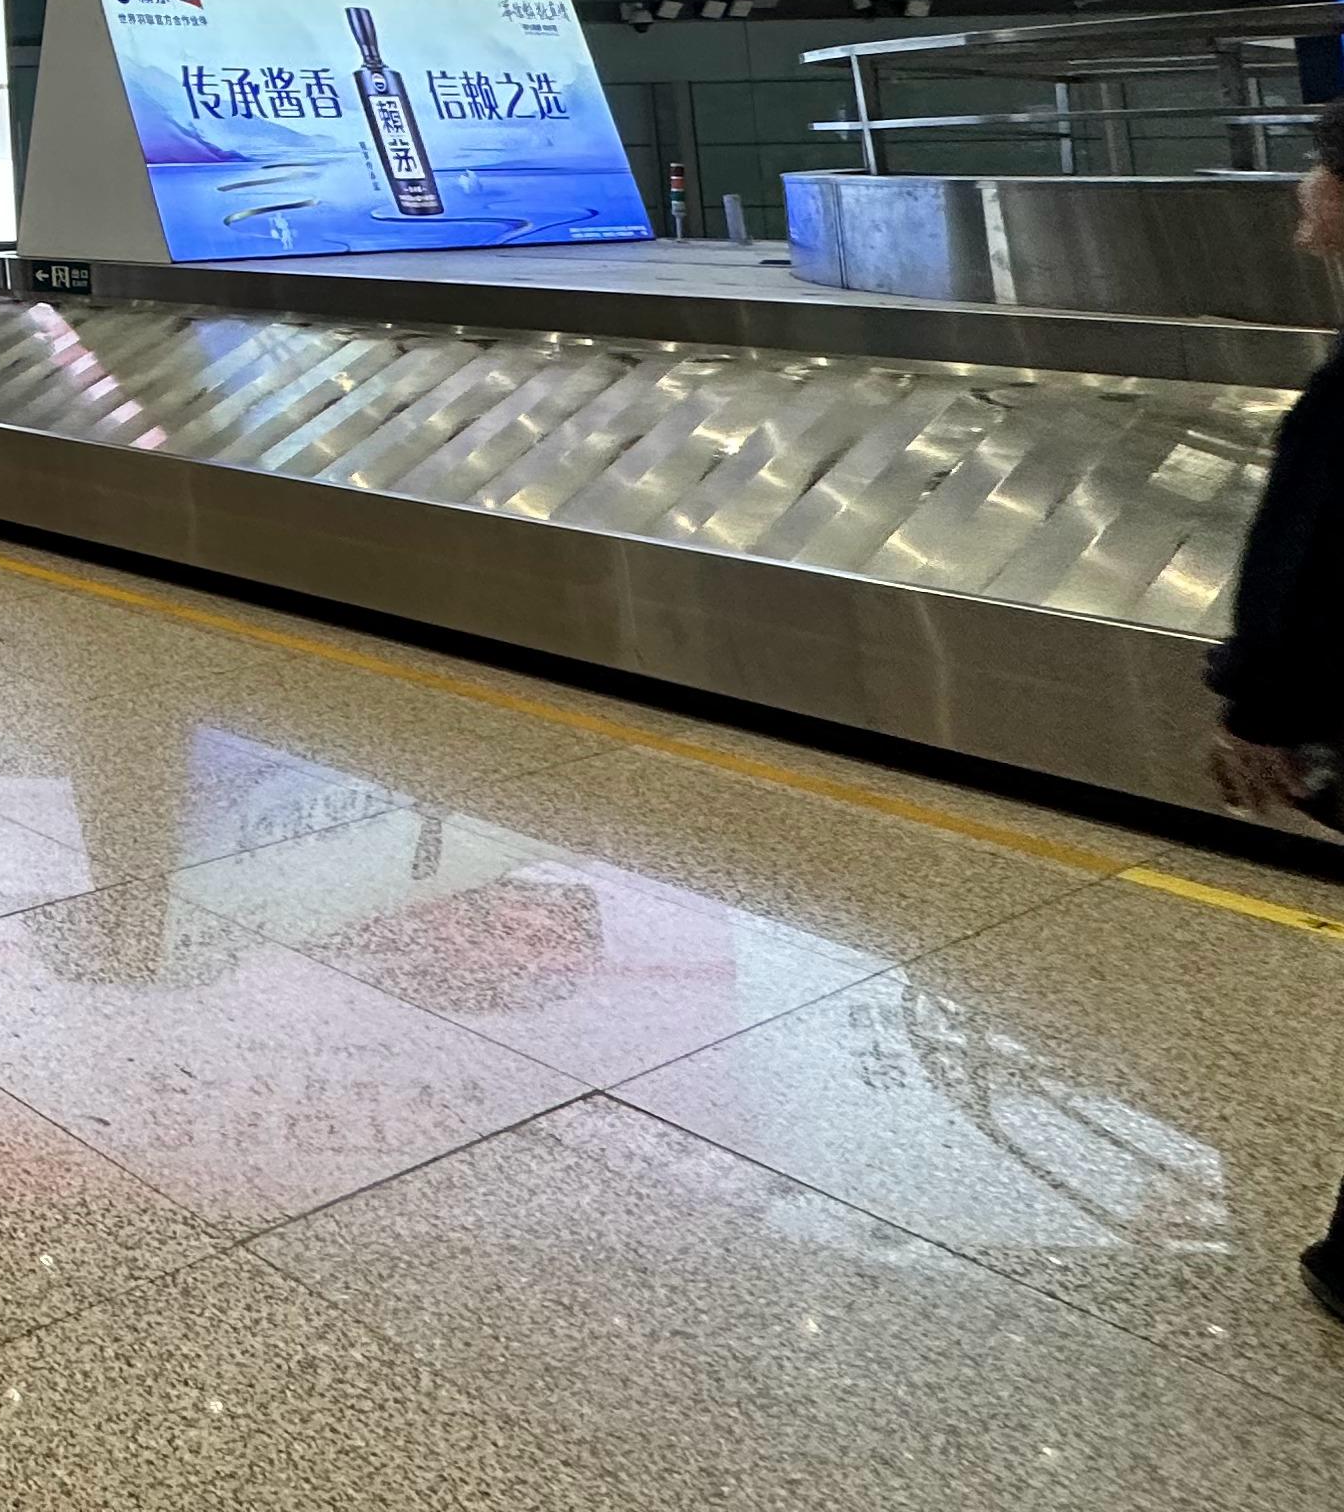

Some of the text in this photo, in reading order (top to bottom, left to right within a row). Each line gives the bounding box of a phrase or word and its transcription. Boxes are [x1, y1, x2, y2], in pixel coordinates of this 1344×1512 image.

[181, 64, 571, 121] 传承酱香 信赖之选
